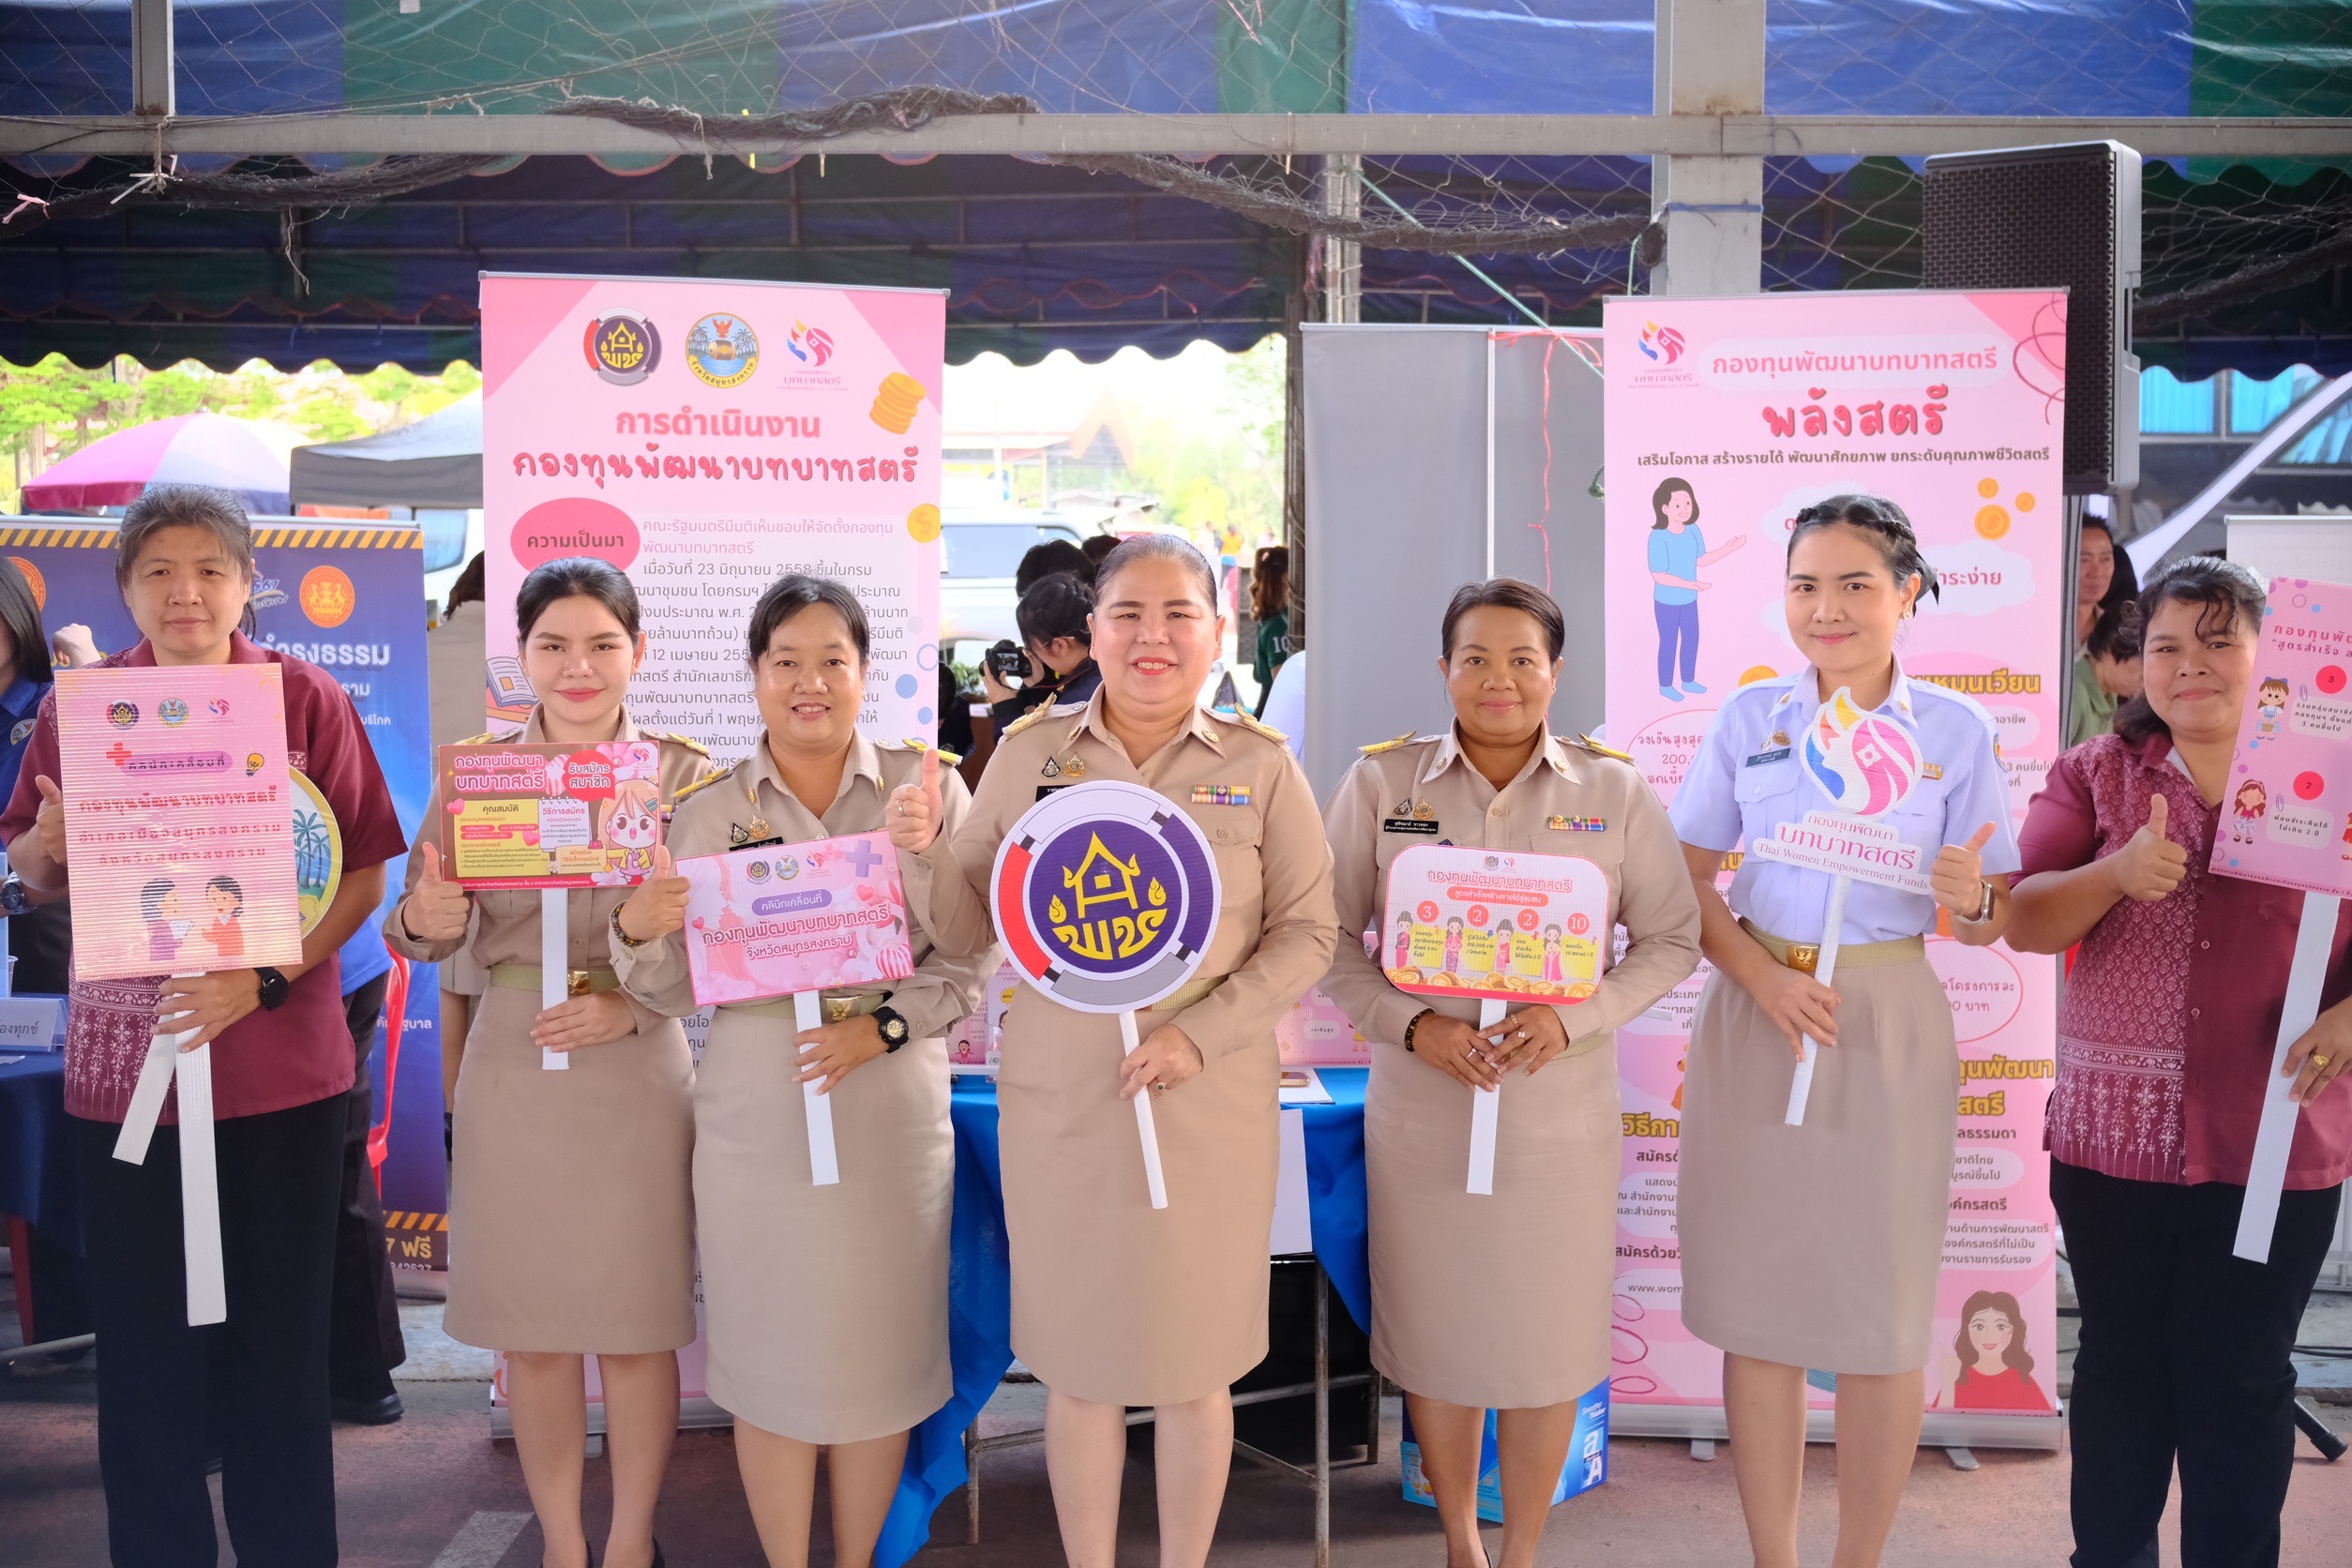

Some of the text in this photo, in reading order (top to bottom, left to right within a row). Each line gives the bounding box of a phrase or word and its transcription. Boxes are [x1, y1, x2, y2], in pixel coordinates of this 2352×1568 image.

[1712, 346, 1998, 379] กองทุนพัฒนาบทบาทสตรี
[1761, 383, 1949, 438] พลังสตรี
[616, 405, 821, 438] การดำเนินงาน
[513, 442, 919, 489] กองทุนพัฒนาบทบาทสตรี
[1637, 446, 2050, 466] เสริมโอกาส สร้างรายได้ พัฒนาศักยภาพ ยกระดับคุณภาพชีวิตสตรี
[527, 530, 625, 549] ความเป็นมา
[643, 539, 754, 555] พัฒนาบทบาทสตรี
[643, 558, 693, 576] เมื่อวันที่
[697, 563, 715, 575] 23
[719, 562, 772, 579] มิถุนายน
[776, 563, 812, 577] 2558
[634, 585, 698, 600] ฒนาชุมชน
[849, 584, 900, 597] ประมาณ
[869, 626, 903, 640] รีมีมติ
[262, 632, 391, 667] ำรงธรรม
[652, 648, 666, 660] 12
[671, 649, 718, 660] เมษายน
[723, 648, 750, 661] 255
[2328, 675, 2334, 684] 3
[340, 683, 370, 697] ราม
[623, 690, 754, 707] ทุนพัฒนาบทบาทสตรี
[629, 708, 715, 726] ผลตั้งแต่วันที่
[1995, 714, 2027, 724] าอาชีพ
[455, 751, 611, 775] กองทุนพัฒนา รับสมัคร
[456, 768, 611, 791] บทบาทสตรี สมาชิก
[2306, 781, 2312, 790] 2
[482, 804, 586, 816] คุณสมบัติ วิธีการสมัคร
[1807, 814, 1893, 841] กองทุนพัฒนา
[1780, 826, 1916, 870] บทบาทสตรี
[1758, 842, 1928, 890] Thai Women Empowerment Funds
[1427, 869, 1574, 893] กองทุนพัฒนาบทบาทสตรี
[761, 890, 823, 912] คลินิกเคลื่อนที่
[701, 903, 891, 946] กองทุนพัฒนาบทบาทสตรี
[1423, 905, 1587, 930] 3 2 2 10
[746, 934, 852, 960] จังหวัดสมุทรสงคราม
[0, 1020, 39, 1039] องทุกข์
[1959, 1053, 2055, 1086] ทุนพัฒนา
[1957, 1090, 2006, 1116] สตรี
[1621, 1111, 1680, 1138] วิธีกา
[1957, 1127, 2017, 1138] ลธรรมดา
[1953, 1153, 1994, 1165] ชาติไทย
[1951, 1169, 2000, 1182] บูรณ์ขึ้นไป
[1630, 1190, 1677, 1201] สำนักงาน
[1949, 1197, 2007, 1211] ค์กรสตรี
[1617, 1206, 1677, 1217] และสำนักงาน
[1945, 1222, 2049, 1234] านด้านการพัฒนาสตรี
[400, 1235, 432, 1259] ฟรี
[1940, 1253, 2031, 1265] งานราชการรับรอง
[1627, 1284, 1682, 1294] www.wom
